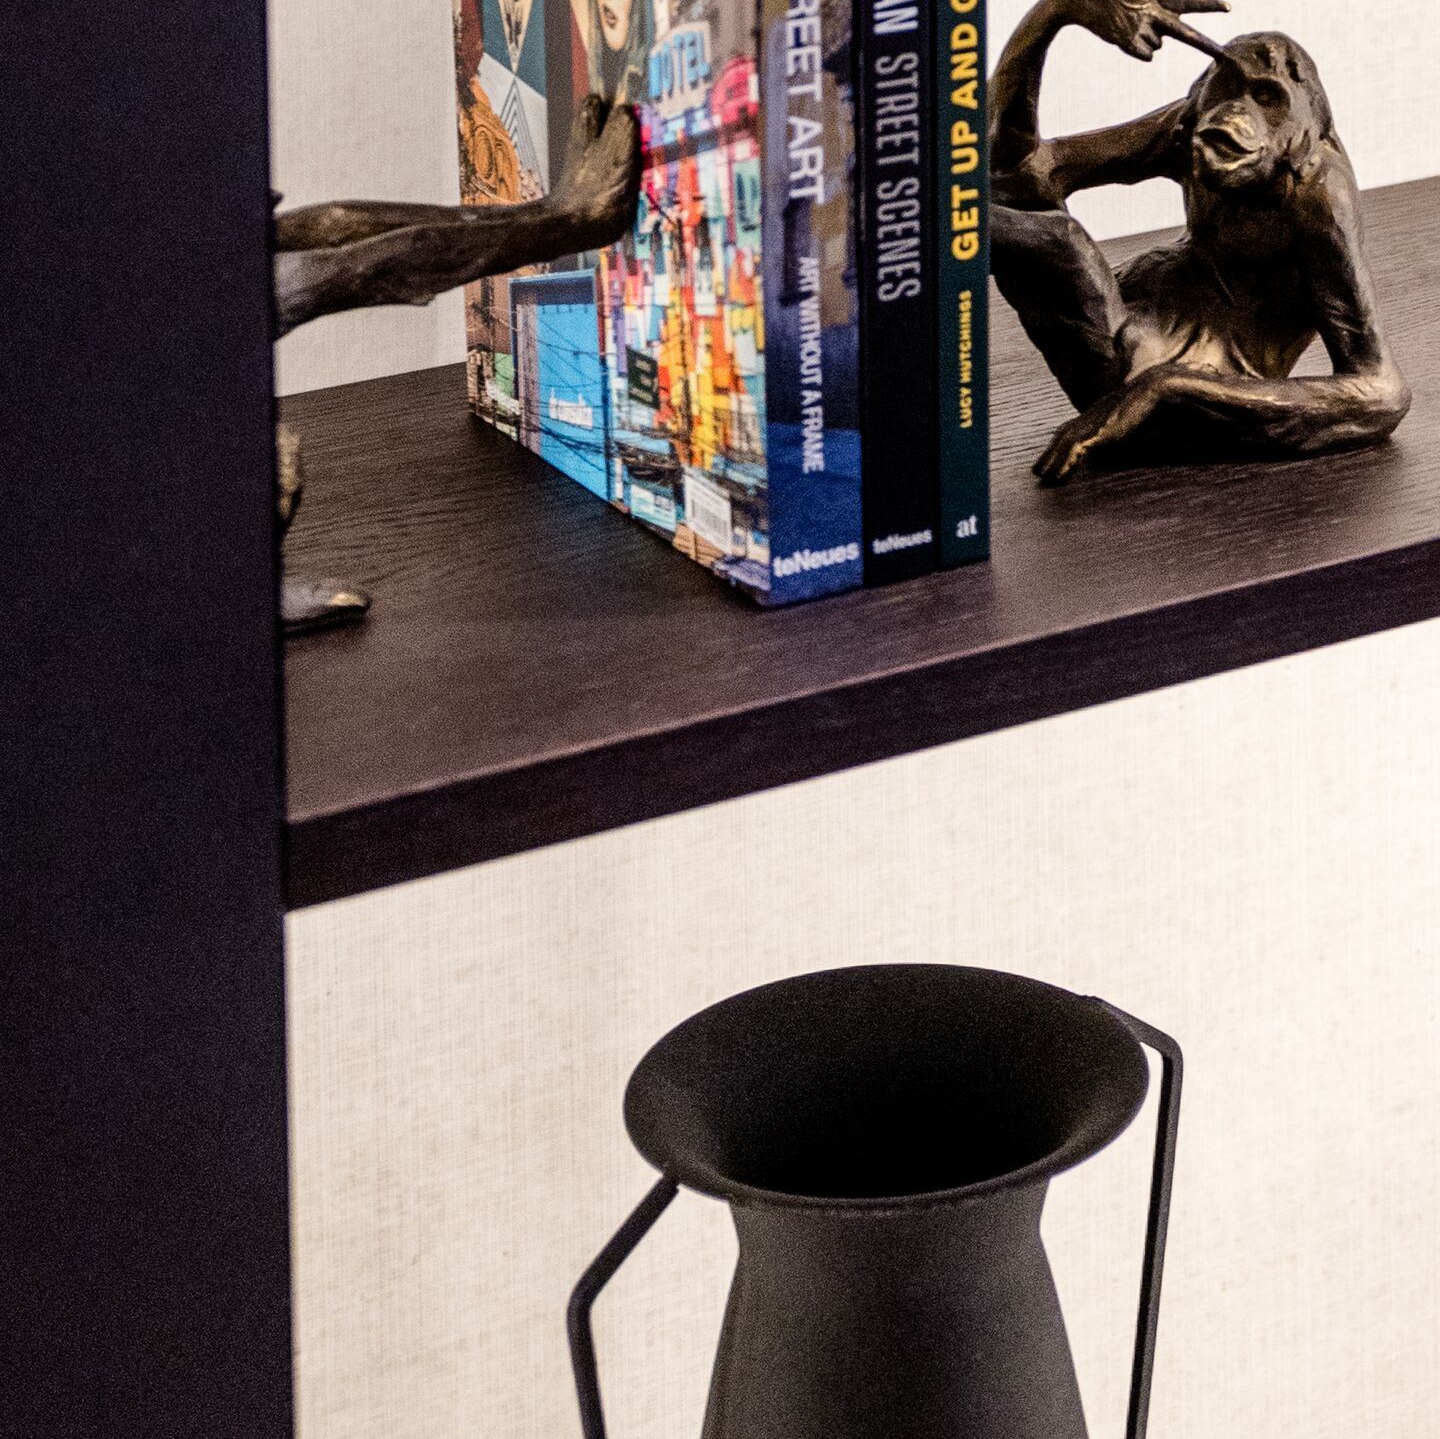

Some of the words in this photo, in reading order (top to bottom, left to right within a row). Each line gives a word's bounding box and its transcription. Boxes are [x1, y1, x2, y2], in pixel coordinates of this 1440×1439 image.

[950, 22, 979, 111] AND
[875, 50, 920, 167] STREET
[787, 115, 825, 206] ART
[950, 119, 980, 175] UP
[876, 176, 922, 303] SCENES
[951, 184, 980, 261] GET
[799, 255, 820, 293] ART
[799, 295, 823, 385] WITHOUT
[957, 289, 972, 384] HUTCHINGS
[801, 390, 823, 406] A
[958, 386, 972, 430] LUCY
[801, 407, 825, 474] FRAME
[773, 541, 861, 579] teNeues
[872, 528, 933, 555] teNeues
[956, 514, 978, 539] at
